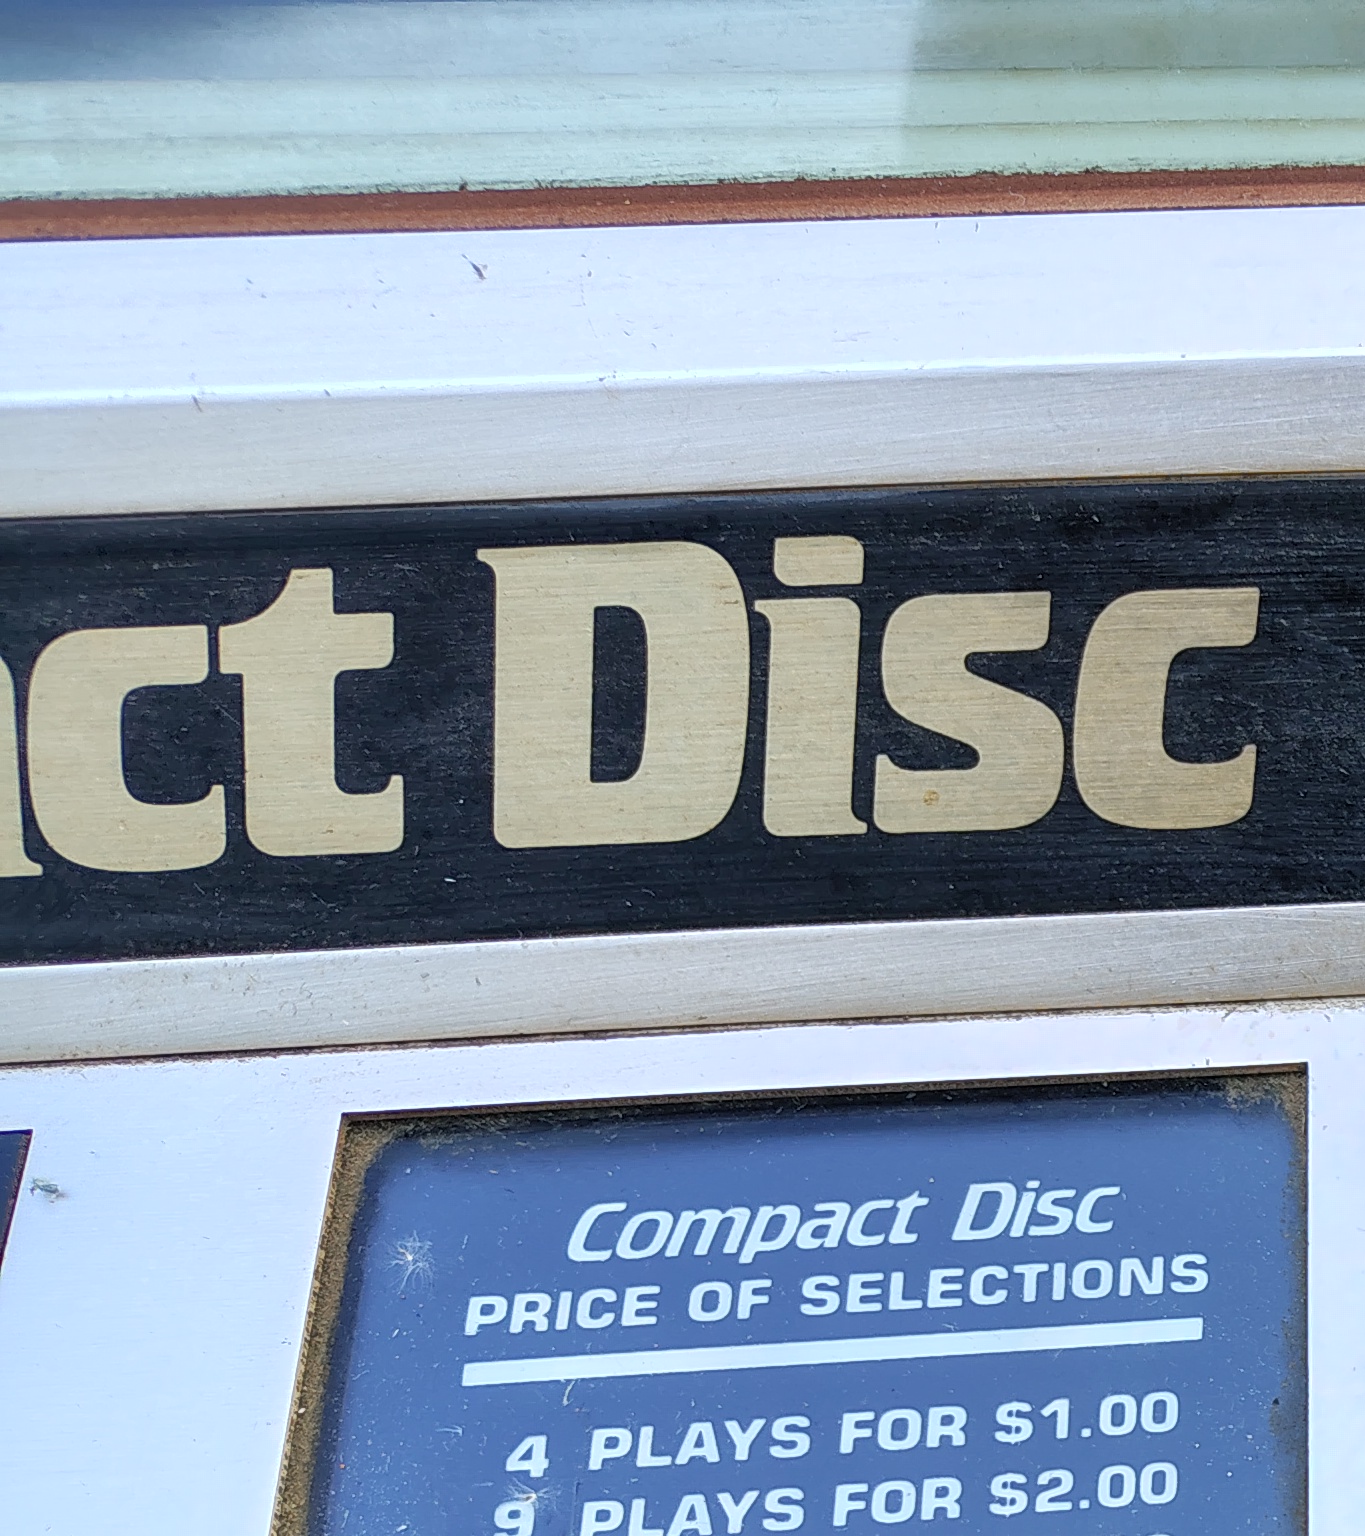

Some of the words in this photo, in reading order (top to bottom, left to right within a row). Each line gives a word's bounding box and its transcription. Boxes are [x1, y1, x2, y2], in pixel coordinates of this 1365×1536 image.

[477, 535, 1260, 849] Disc
[567, 1190, 930, 1263] Compact
[951, 1180, 1120, 1241] Disc
[464, 1285, 661, 1336] PRICE
[688, 1279, 772, 1322] OF
[800, 1254, 1209, 1316] SELECTIONS
[505, 1434, 550, 1478] 4
[588, 1416, 812, 1471] PLAYS
[839, 1405, 968, 1454] FOR
[994, 1391, 1180, 1445] $1.00
[833, 1477, 963, 1527] FOR
[988, 1461, 1179, 1518] $2.00
